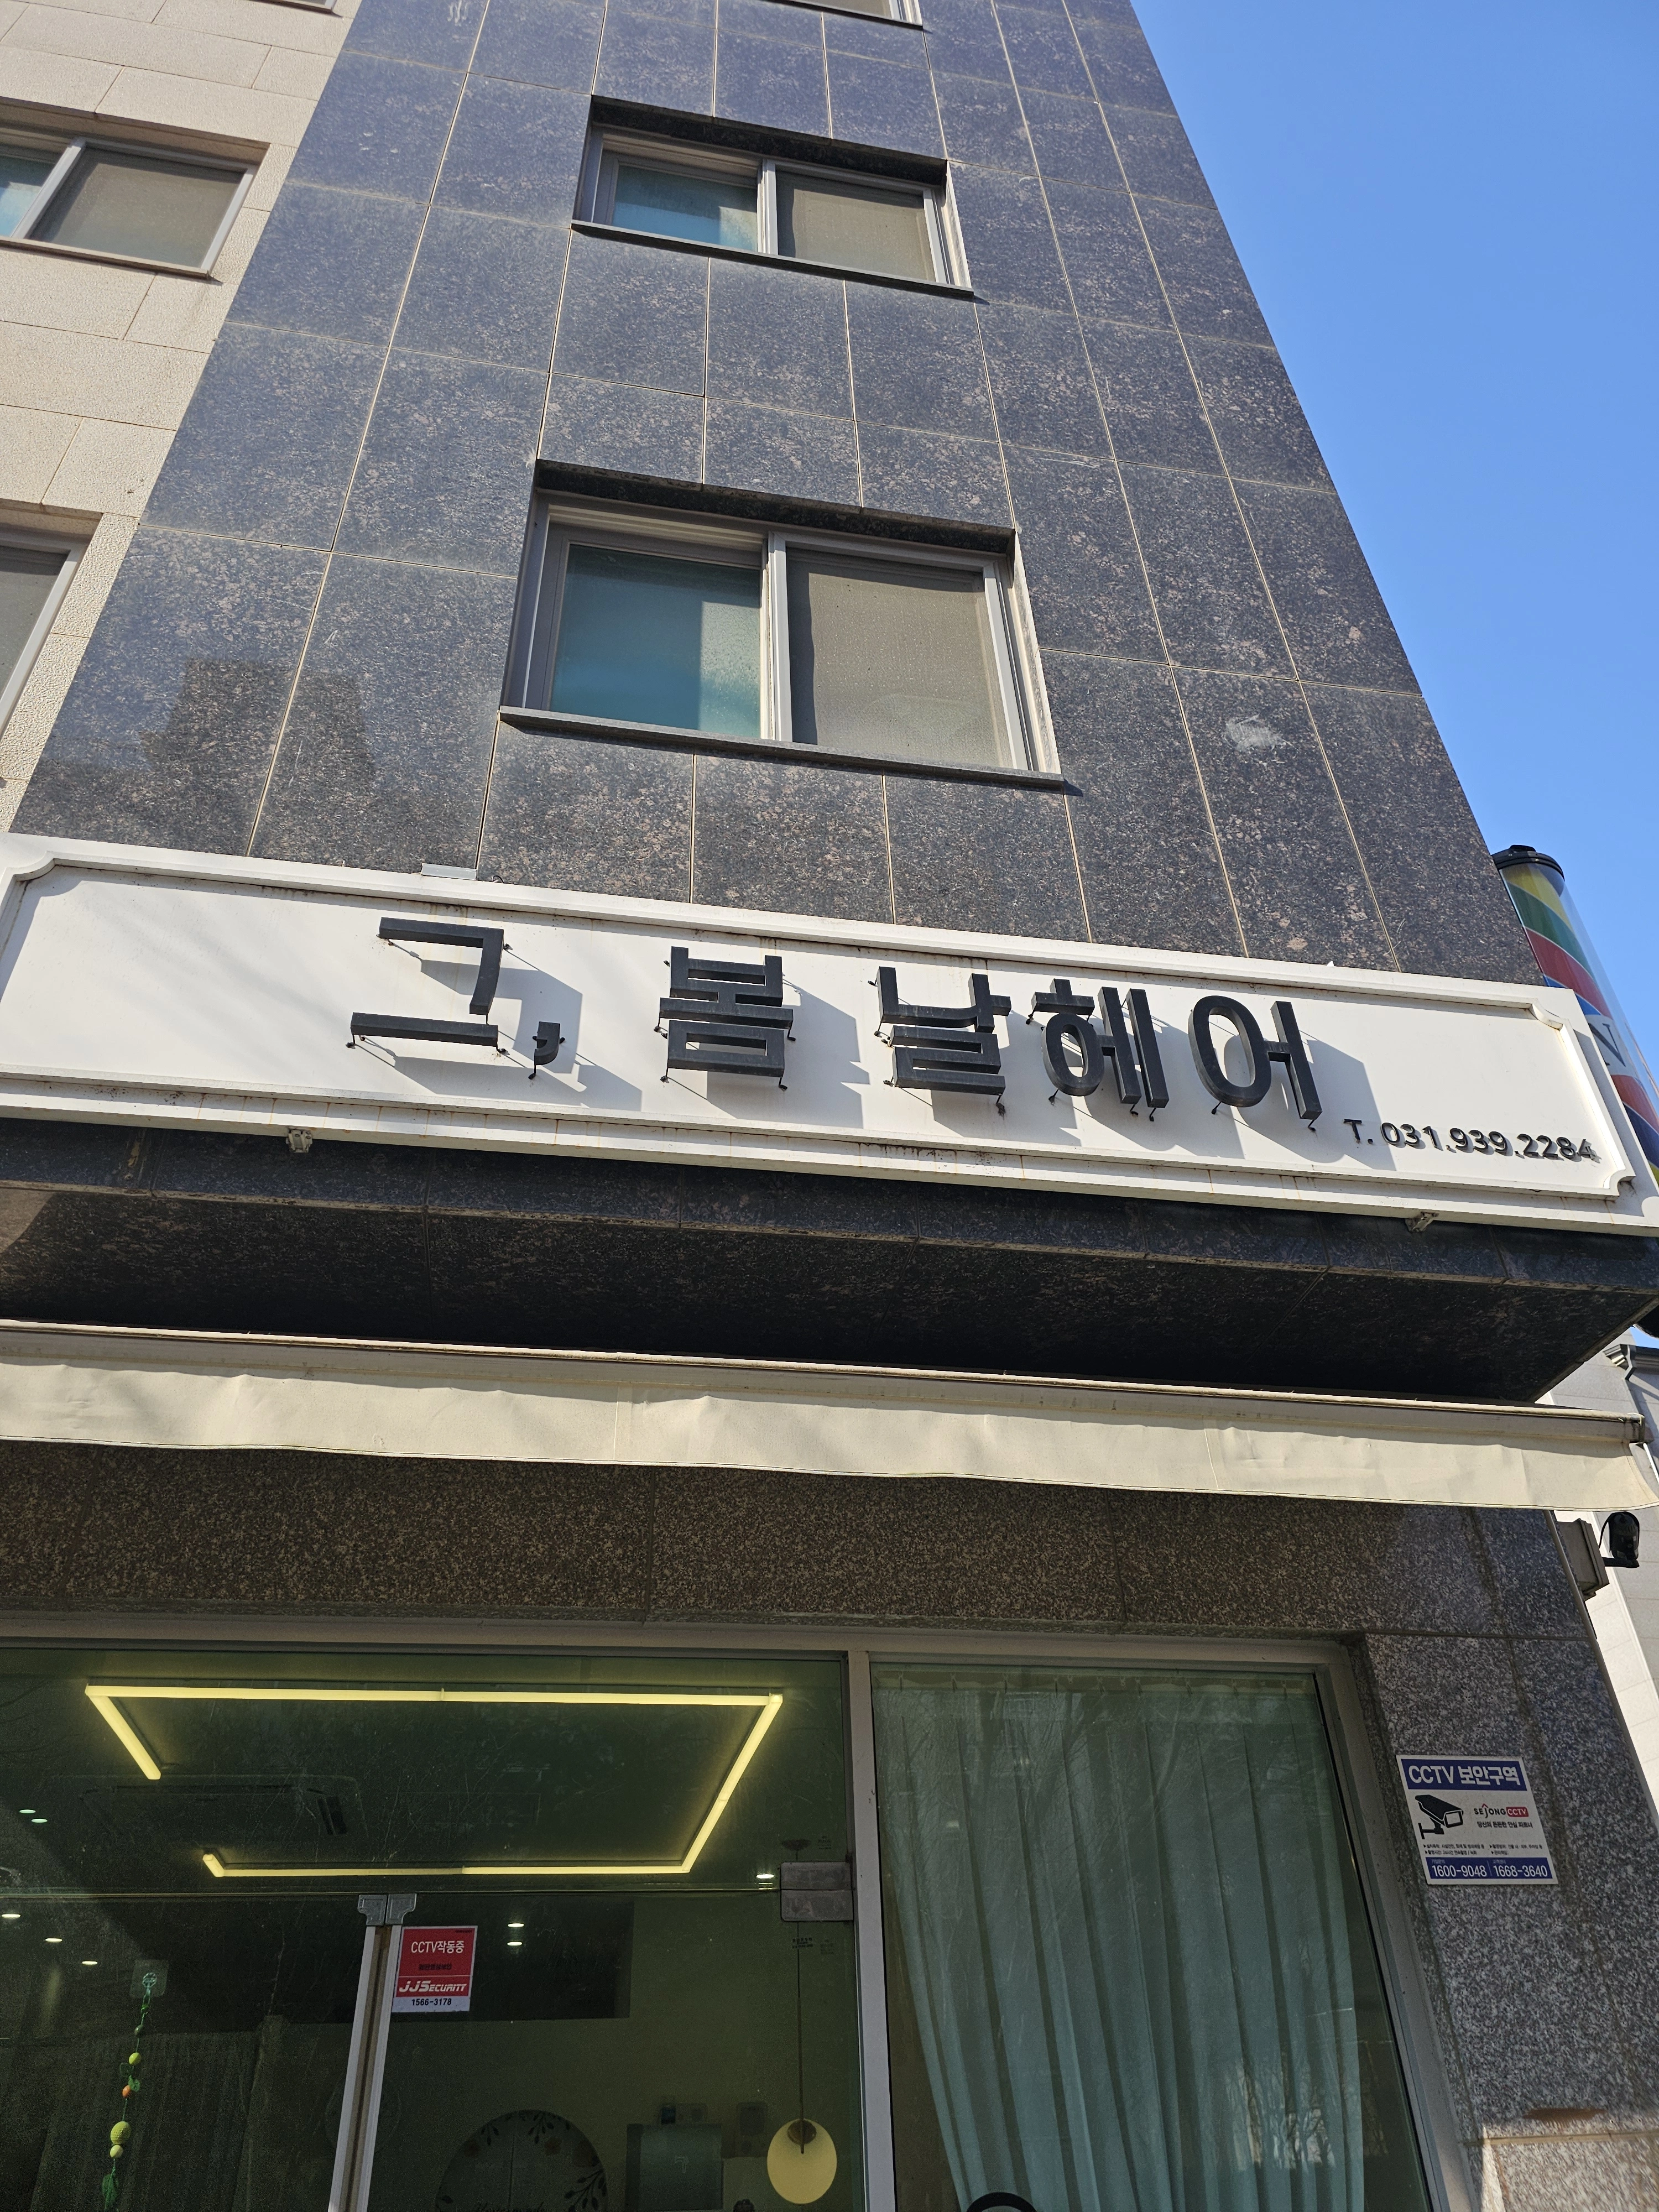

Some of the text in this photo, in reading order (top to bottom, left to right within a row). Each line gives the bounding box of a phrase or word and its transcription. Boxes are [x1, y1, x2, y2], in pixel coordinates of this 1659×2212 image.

[1408, 1765, 1520, 1786] CCTV 보안구역
[1432, 1865, 1487, 1877] 1600-9048
[1493, 1865, 1548, 1877] 1668-3640
[411, 1940, 465, 1954] CCTV작동중
[411, 1997, 452, 2006] 1566-3178
